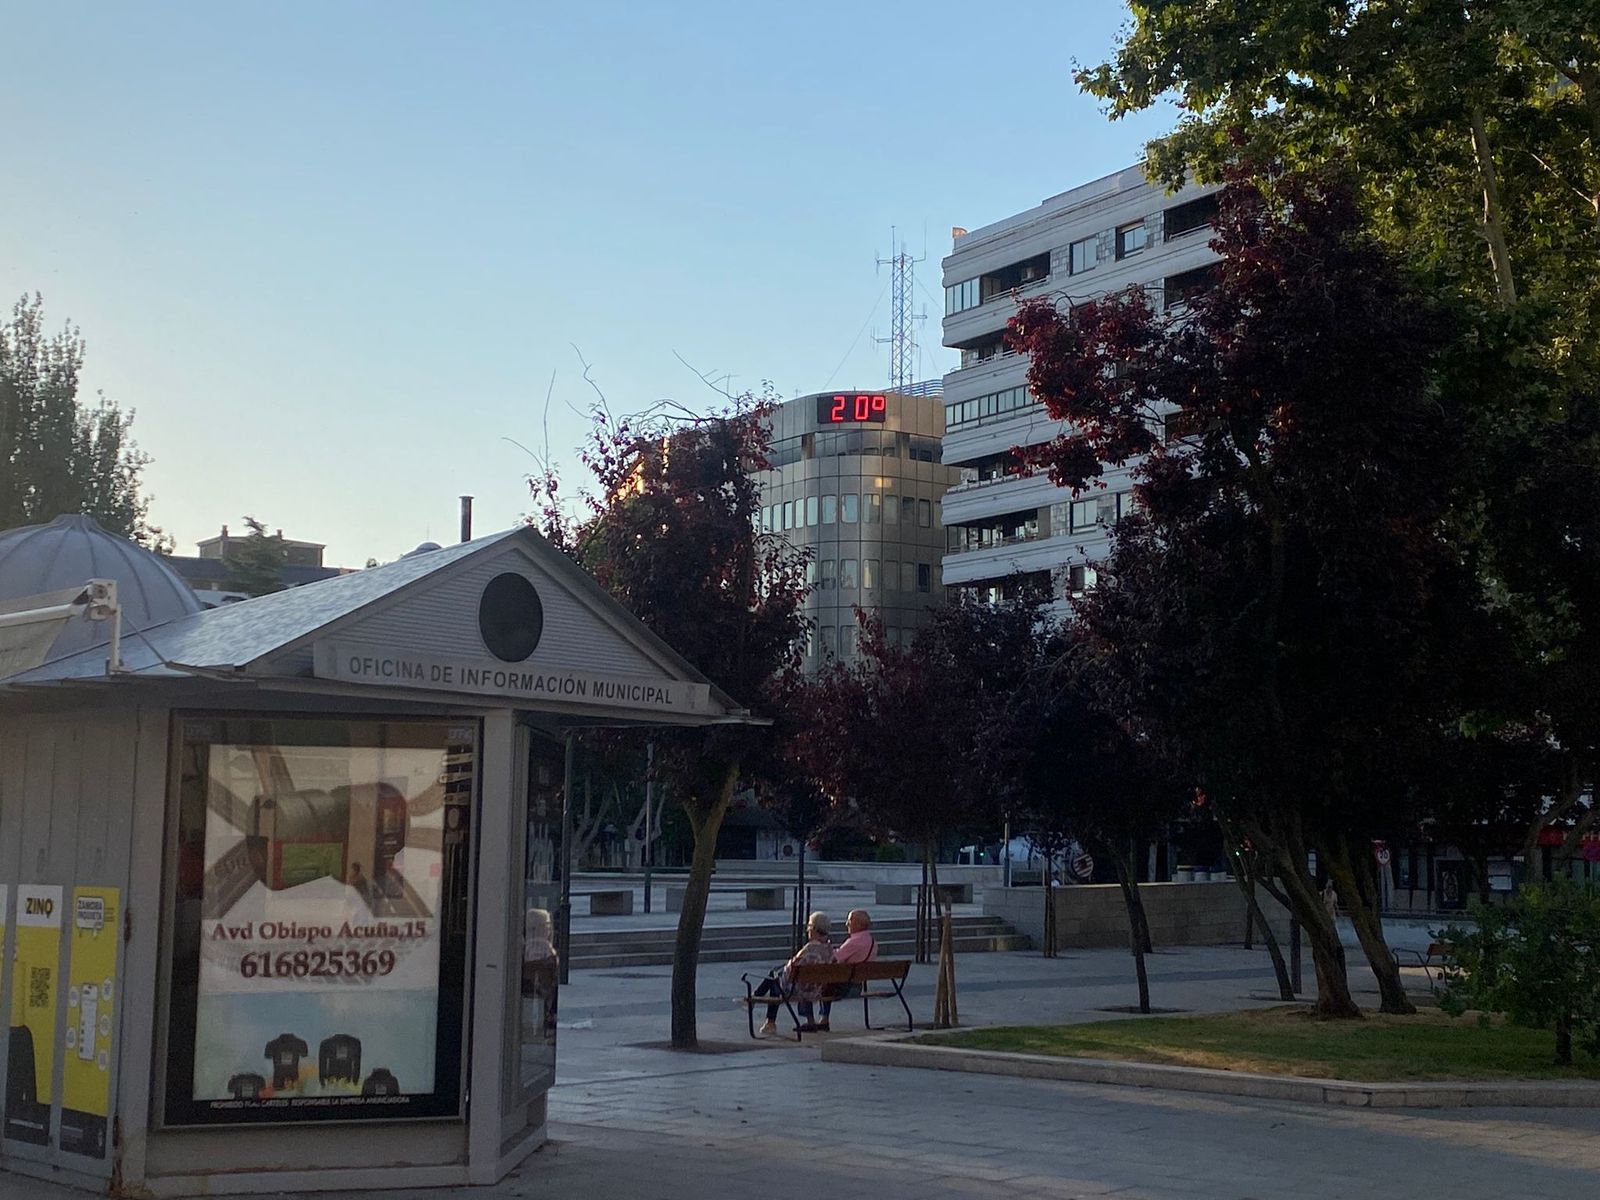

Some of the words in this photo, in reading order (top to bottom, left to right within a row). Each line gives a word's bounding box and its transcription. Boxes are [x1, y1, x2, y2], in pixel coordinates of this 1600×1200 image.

[349, 656, 425, 682] OFICINA
[431, 664, 453, 684] DE
[460, 667, 587, 697] INFORMACIÓN
[592, 681, 674, 706] MUNICIPAL
[212, 922, 253, 941] Avd
[258, 921, 332, 944] Obispo
[240, 950, 396, 978] 616825369
